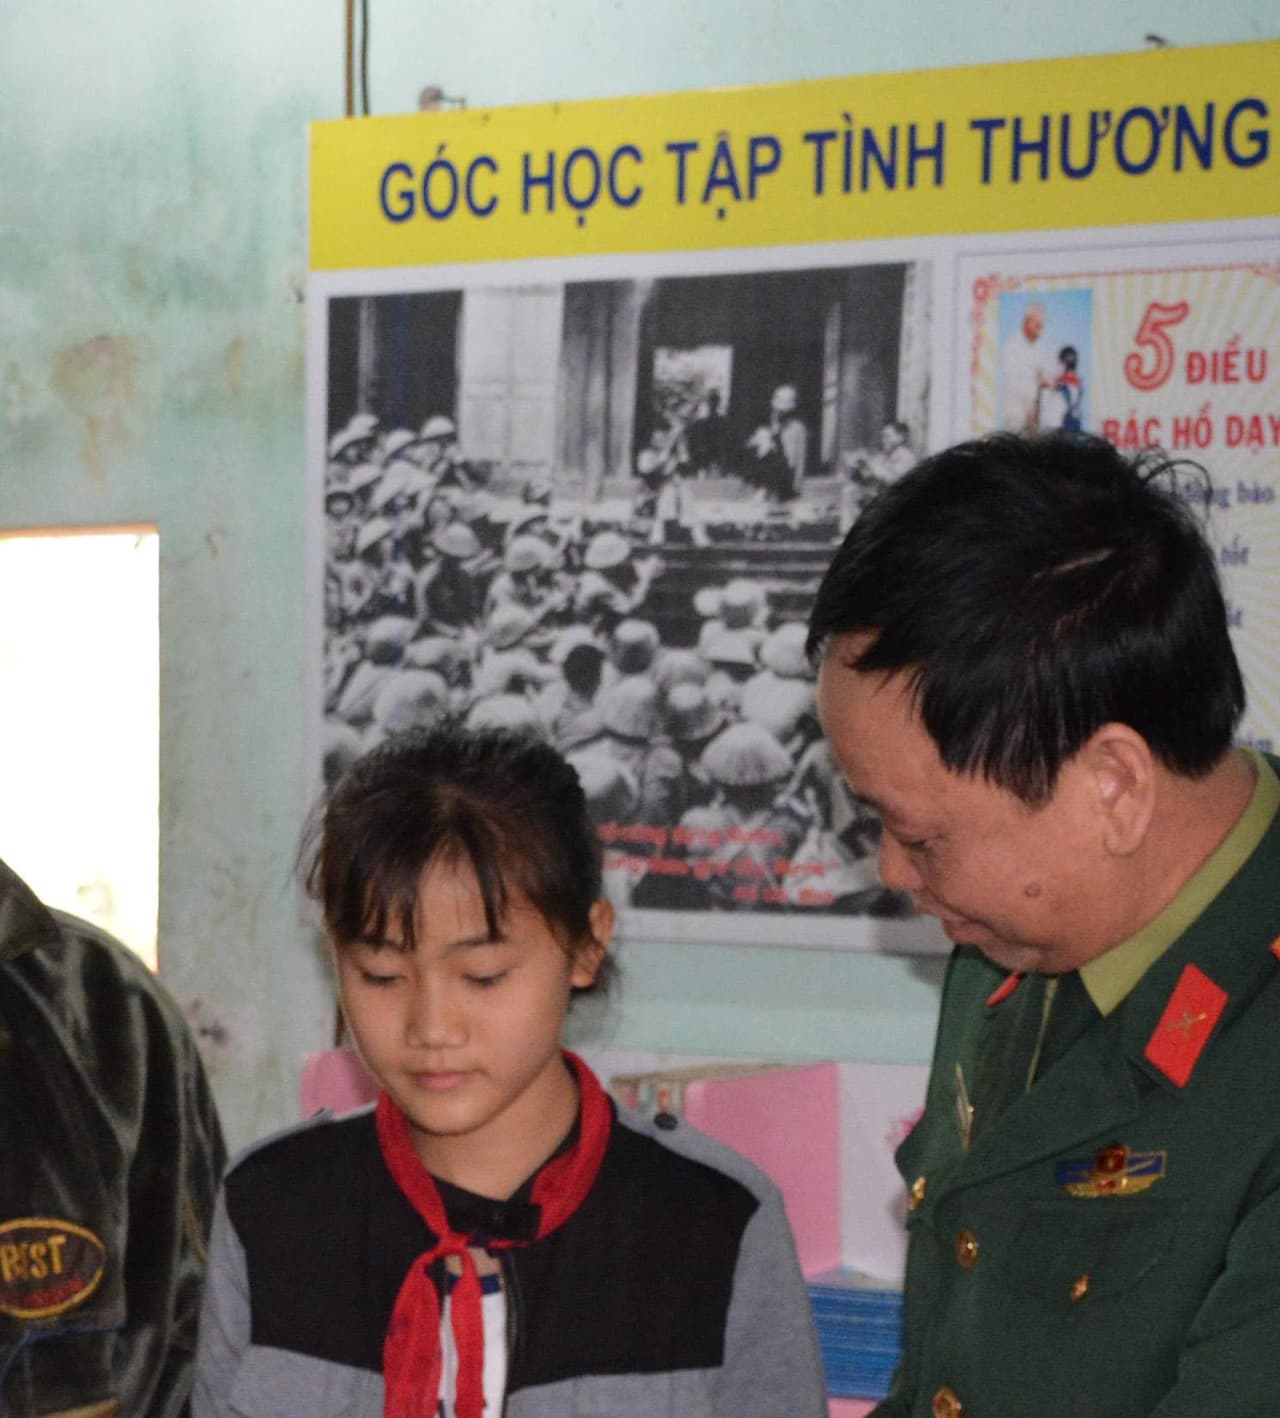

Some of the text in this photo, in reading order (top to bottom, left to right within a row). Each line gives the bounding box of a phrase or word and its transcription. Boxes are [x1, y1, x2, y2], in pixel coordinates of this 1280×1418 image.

[379, 97, 1271, 228] GÓC HỌC TẬP TÌNH THƯƠNG
[1123, 301, 1189, 393] 5
